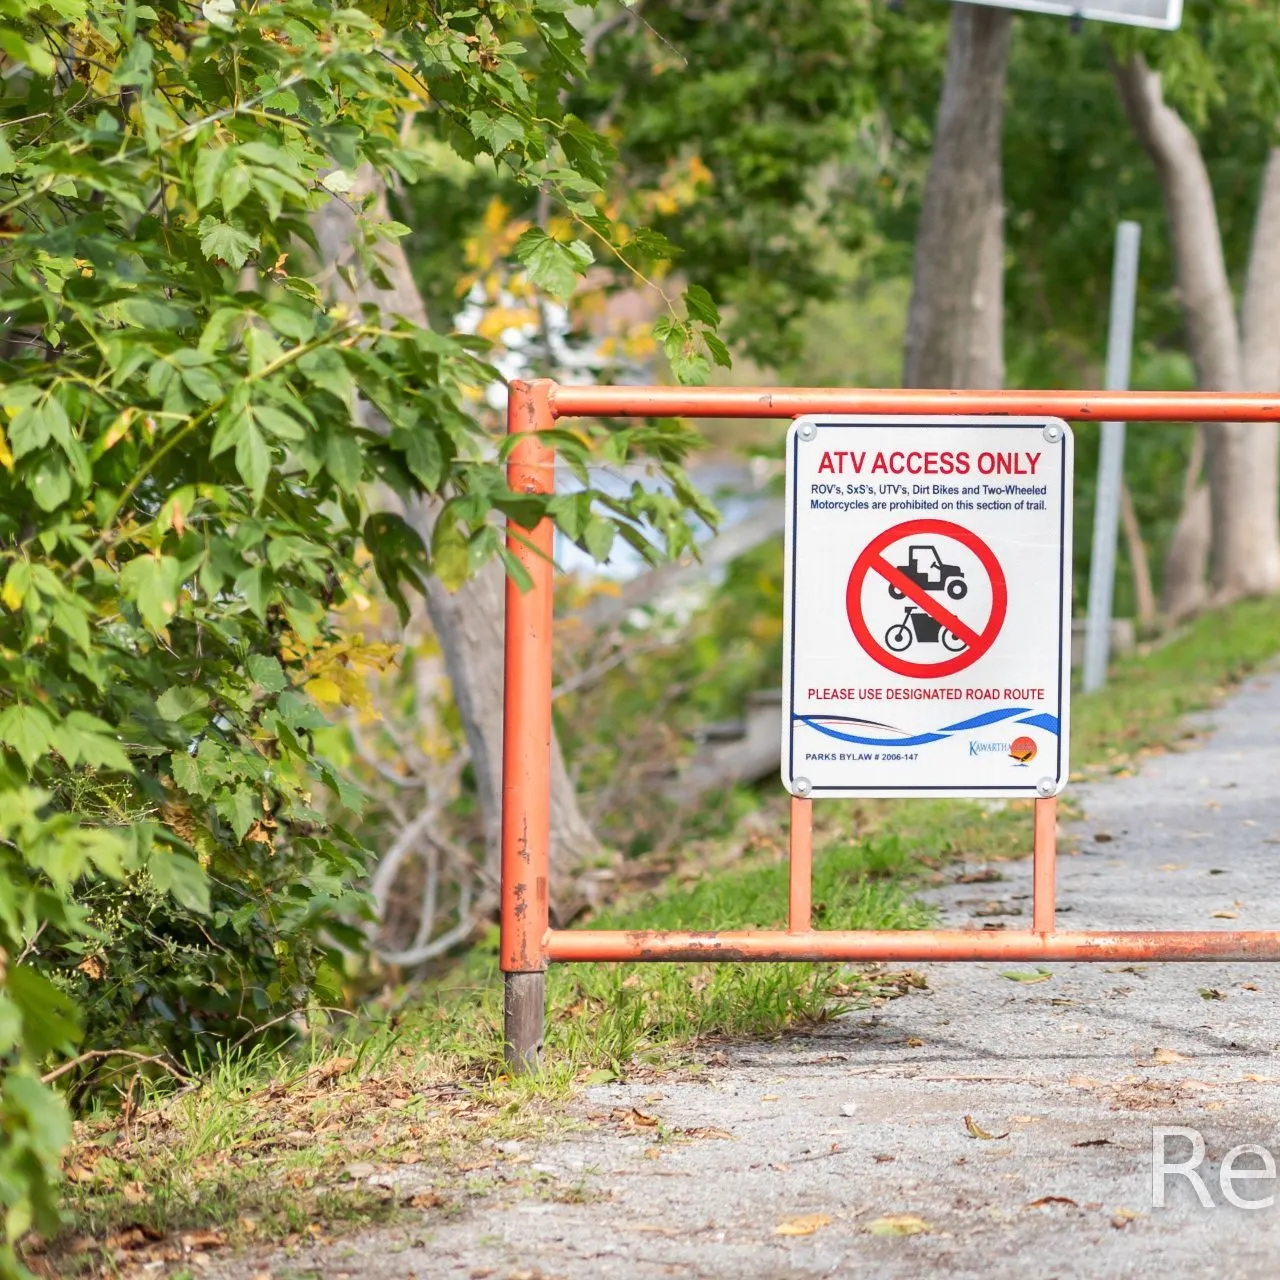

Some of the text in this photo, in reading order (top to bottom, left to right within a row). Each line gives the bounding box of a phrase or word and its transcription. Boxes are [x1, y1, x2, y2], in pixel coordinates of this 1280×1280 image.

[818, 451, 1042, 475] ATV ACCESS ONLY
[811, 484, 1047, 496] ROV's, SxS's, UTV's, Dirt Bikes and Two-Wheeled
[810, 499, 1047, 512] Motorcycles are prohibited on this section of trail.
[808, 688, 1045, 700] PLEASE USE DESIGNATED ROAD ROUTE
[969, 740, 1012, 756] KAWARTHA
[805, 753, 919, 761] PARKS BYLAW # 2006-147
